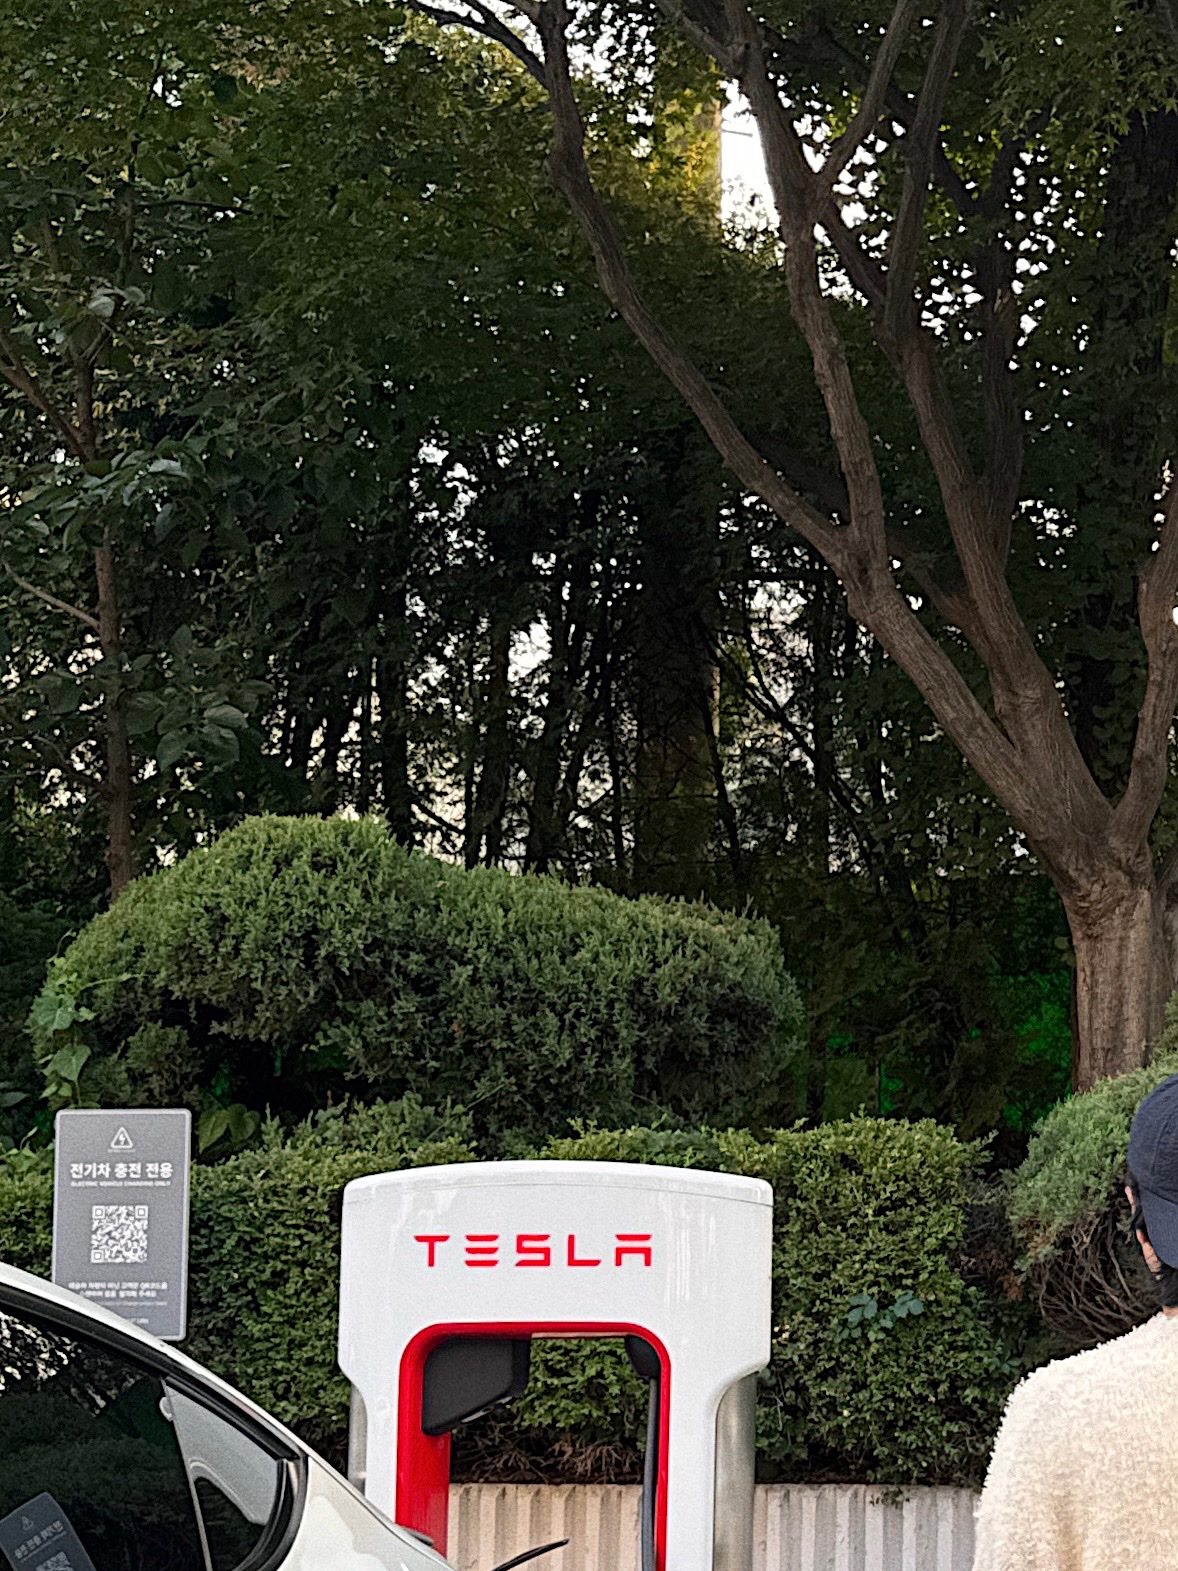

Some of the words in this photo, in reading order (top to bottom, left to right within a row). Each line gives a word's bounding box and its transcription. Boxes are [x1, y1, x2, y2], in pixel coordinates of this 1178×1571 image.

[70, 1162, 111, 1178] 전기차
[114, 1162, 142, 1178] 충전
[146, 1162, 173, 1178] 전용
[414, 1233, 653, 1268] TESLA
